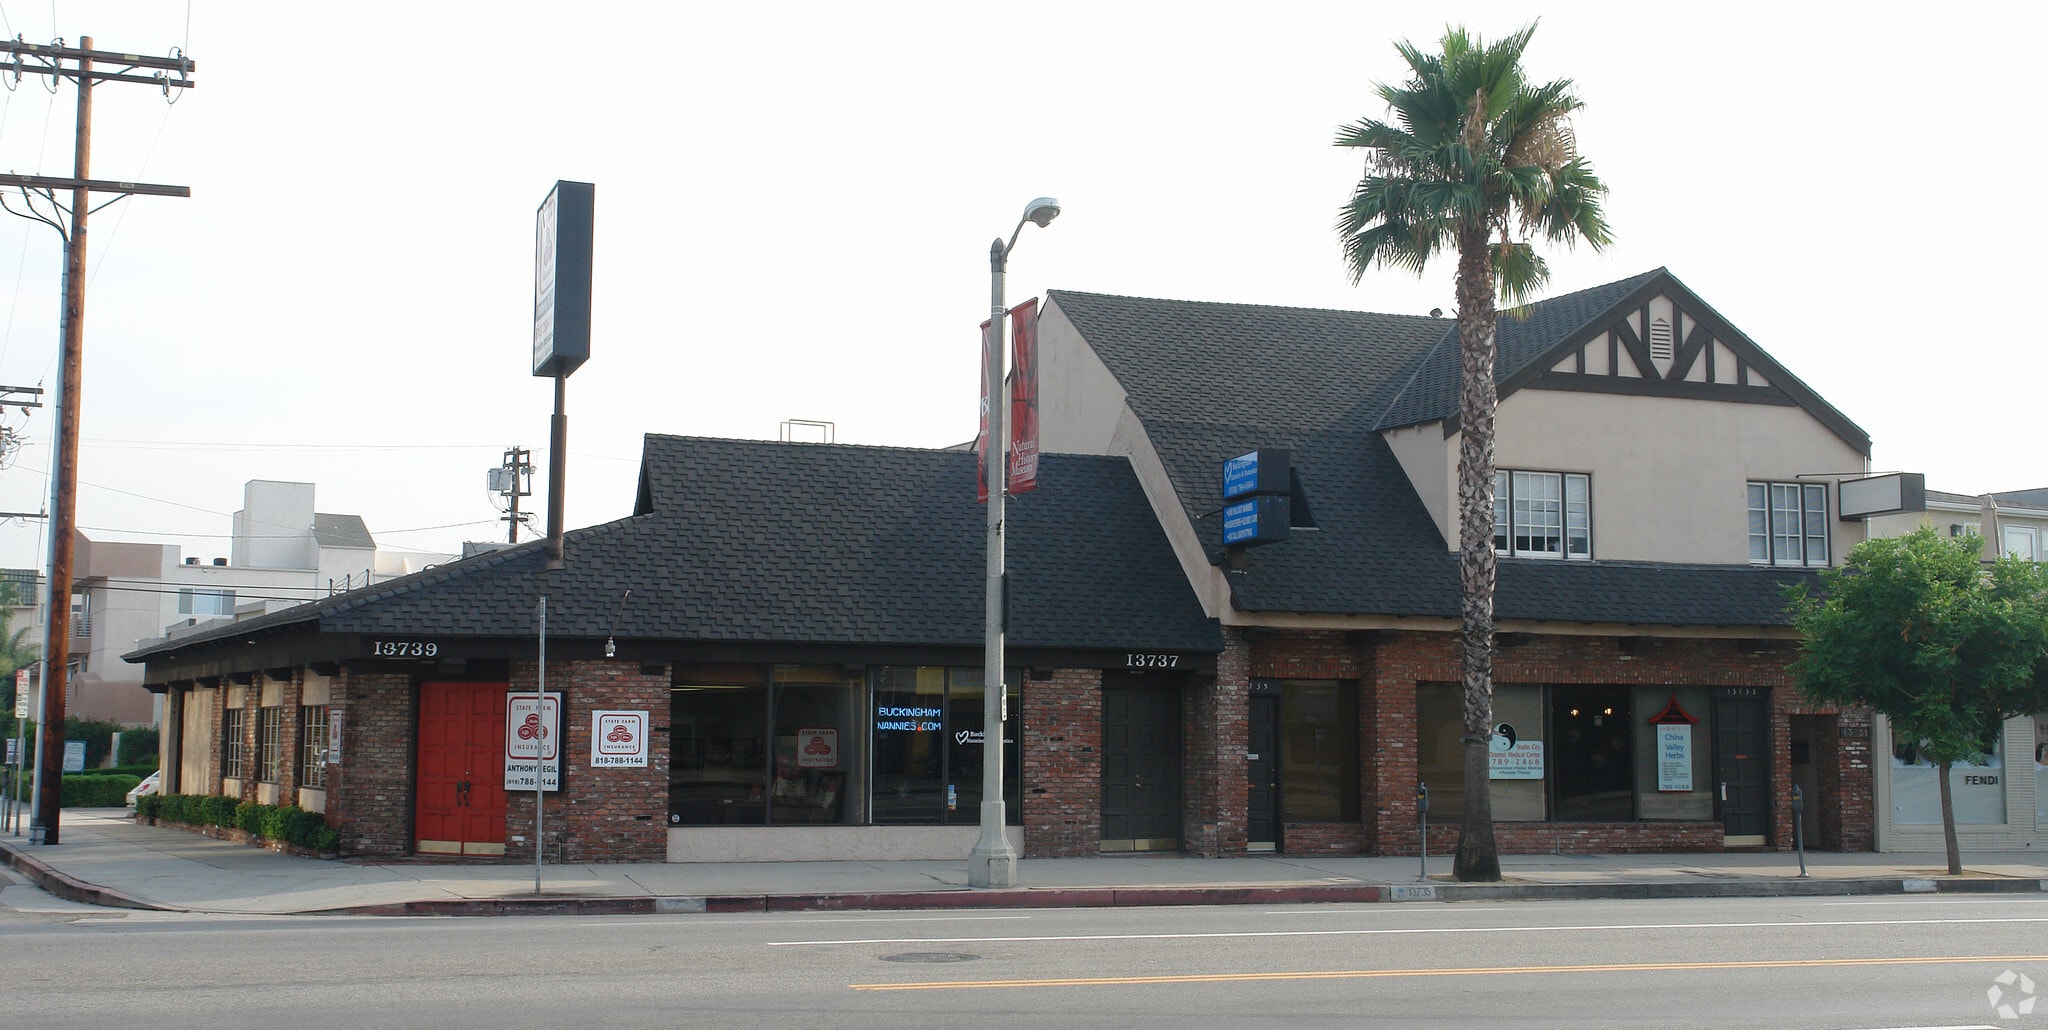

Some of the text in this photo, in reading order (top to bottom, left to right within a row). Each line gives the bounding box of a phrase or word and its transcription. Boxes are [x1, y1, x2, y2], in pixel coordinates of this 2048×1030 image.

[1012, 437, 1035, 457] Natural
[1018, 453, 1037, 466] History
[1010, 462, 1033, 476] Museum
[374, 641, 438, 657] 13739
[1126, 653, 1179, 668] 13737
[878, 707, 941, 717] BUCKINGHAM
[877, 721, 942, 732] NANNIES.COM
[1665, 733, 1684, 741] China
[1665, 743, 1685, 753] Valley
[1665, 752, 1685, 760] Herbs
[507, 764, 538, 773] ANTHONY
[1965, 775, 1999, 786] FENDI
[1408, 887, 1432, 897] 13735
